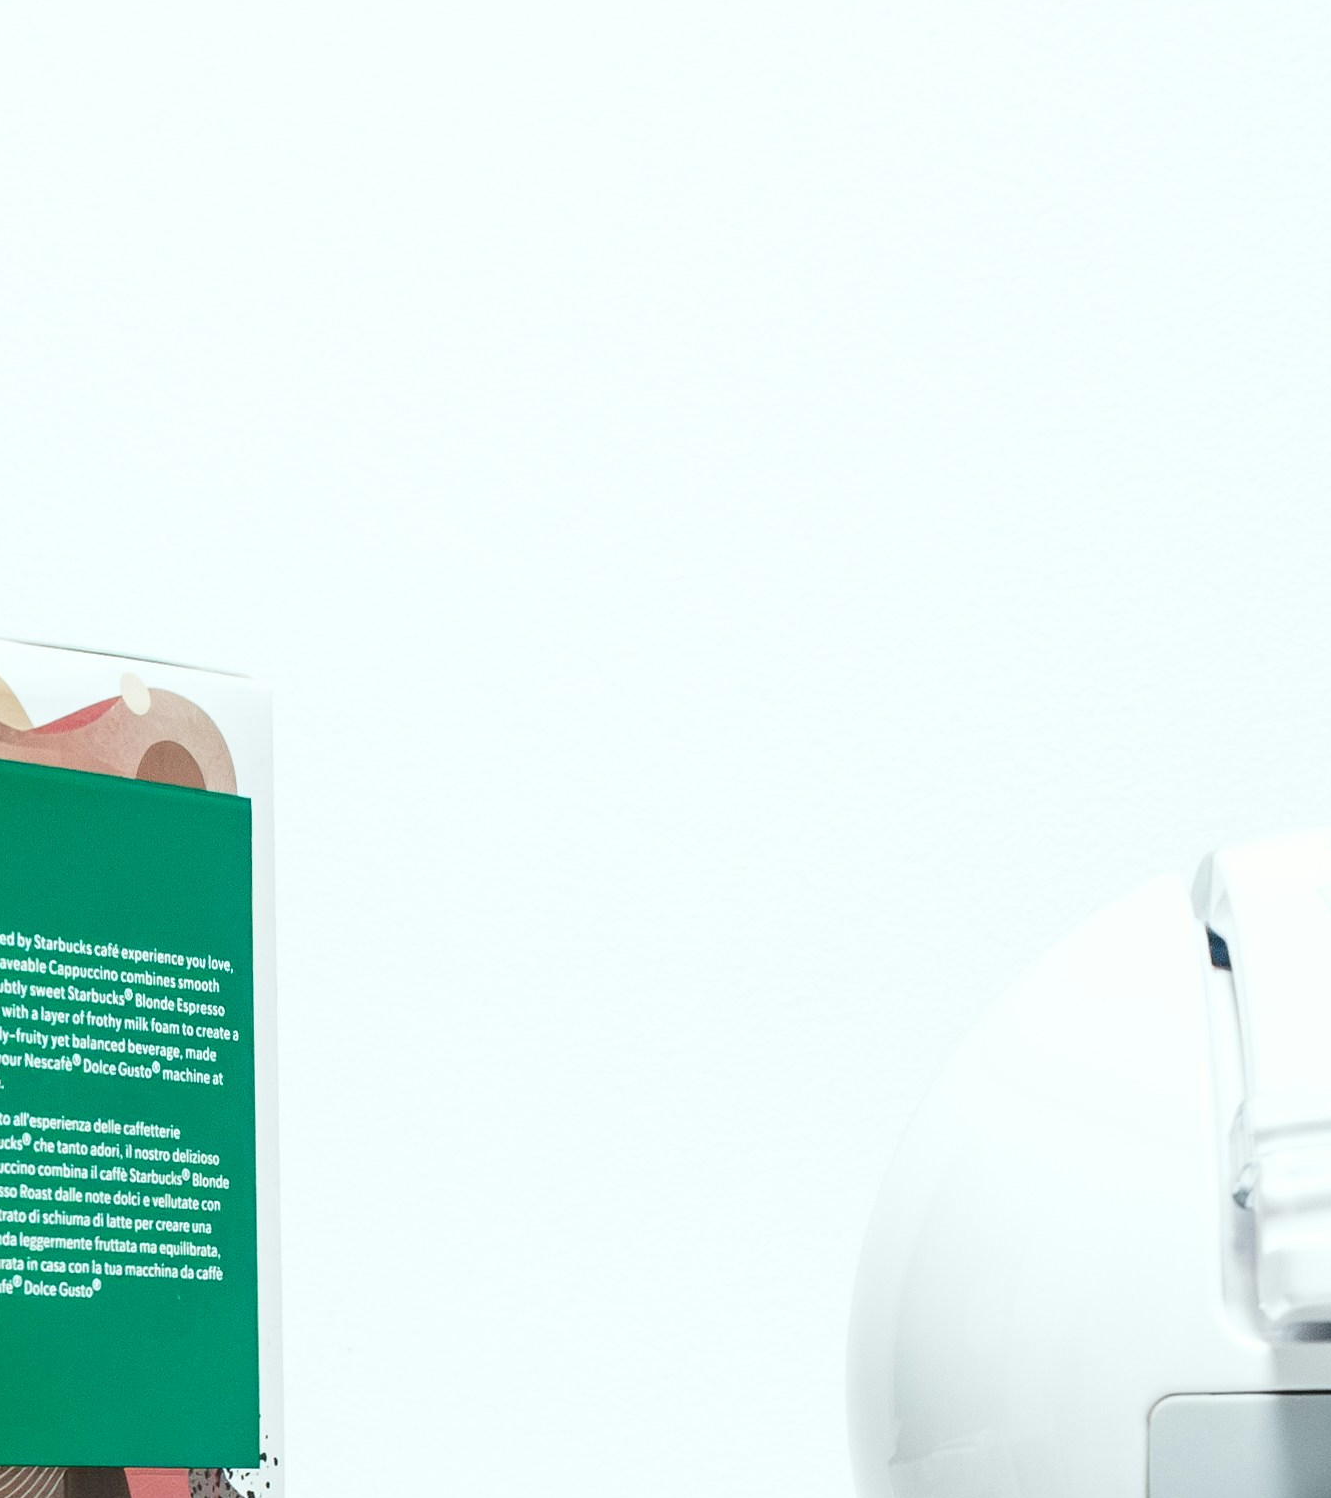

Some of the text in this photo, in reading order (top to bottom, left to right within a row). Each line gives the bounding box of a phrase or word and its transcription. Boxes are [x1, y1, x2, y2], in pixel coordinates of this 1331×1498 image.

[17, 933, 32, 951] by
[34, 934, 92, 955] Starbucks
[121, 948, 184, 966] experience
[186, 957, 206, 969] you
[208, 956, 233, 973] love,
[49, 960, 118, 981] Cappuccino
[121, 971, 176, 988] combines
[178, 978, 219, 992] smooth
[30, 985, 65, 999] sweet
[136, 993, 174, 1011] Blonde
[177, 998, 225, 1016] Espresso
[2, 1004, 28, 1018] with
[32, 1010, 38, 1020] a
[41, 1007, 70, 1025] layer
[72, 1010, 84, 1024] of
[87, 1011, 122, 1031] frothy
[124, 1017, 148, 1031] milk
[151, 1018, 179, 1034] foam
[182, 1024, 194, 1036] to
[196, 1027, 230, 1040] create
[233, 1031, 238, 1041] a
[51, 1035, 69, 1049] yet
[72, 1034, 125, 1052] balanced
[128, 1040, 182, 1061] beverage,
[186, 1047, 216, 1061] made
[84, 1058, 116, 1075] Dolce
[163, 1068, 210, 1084] machine
[213, 1073, 223, 1085] at
